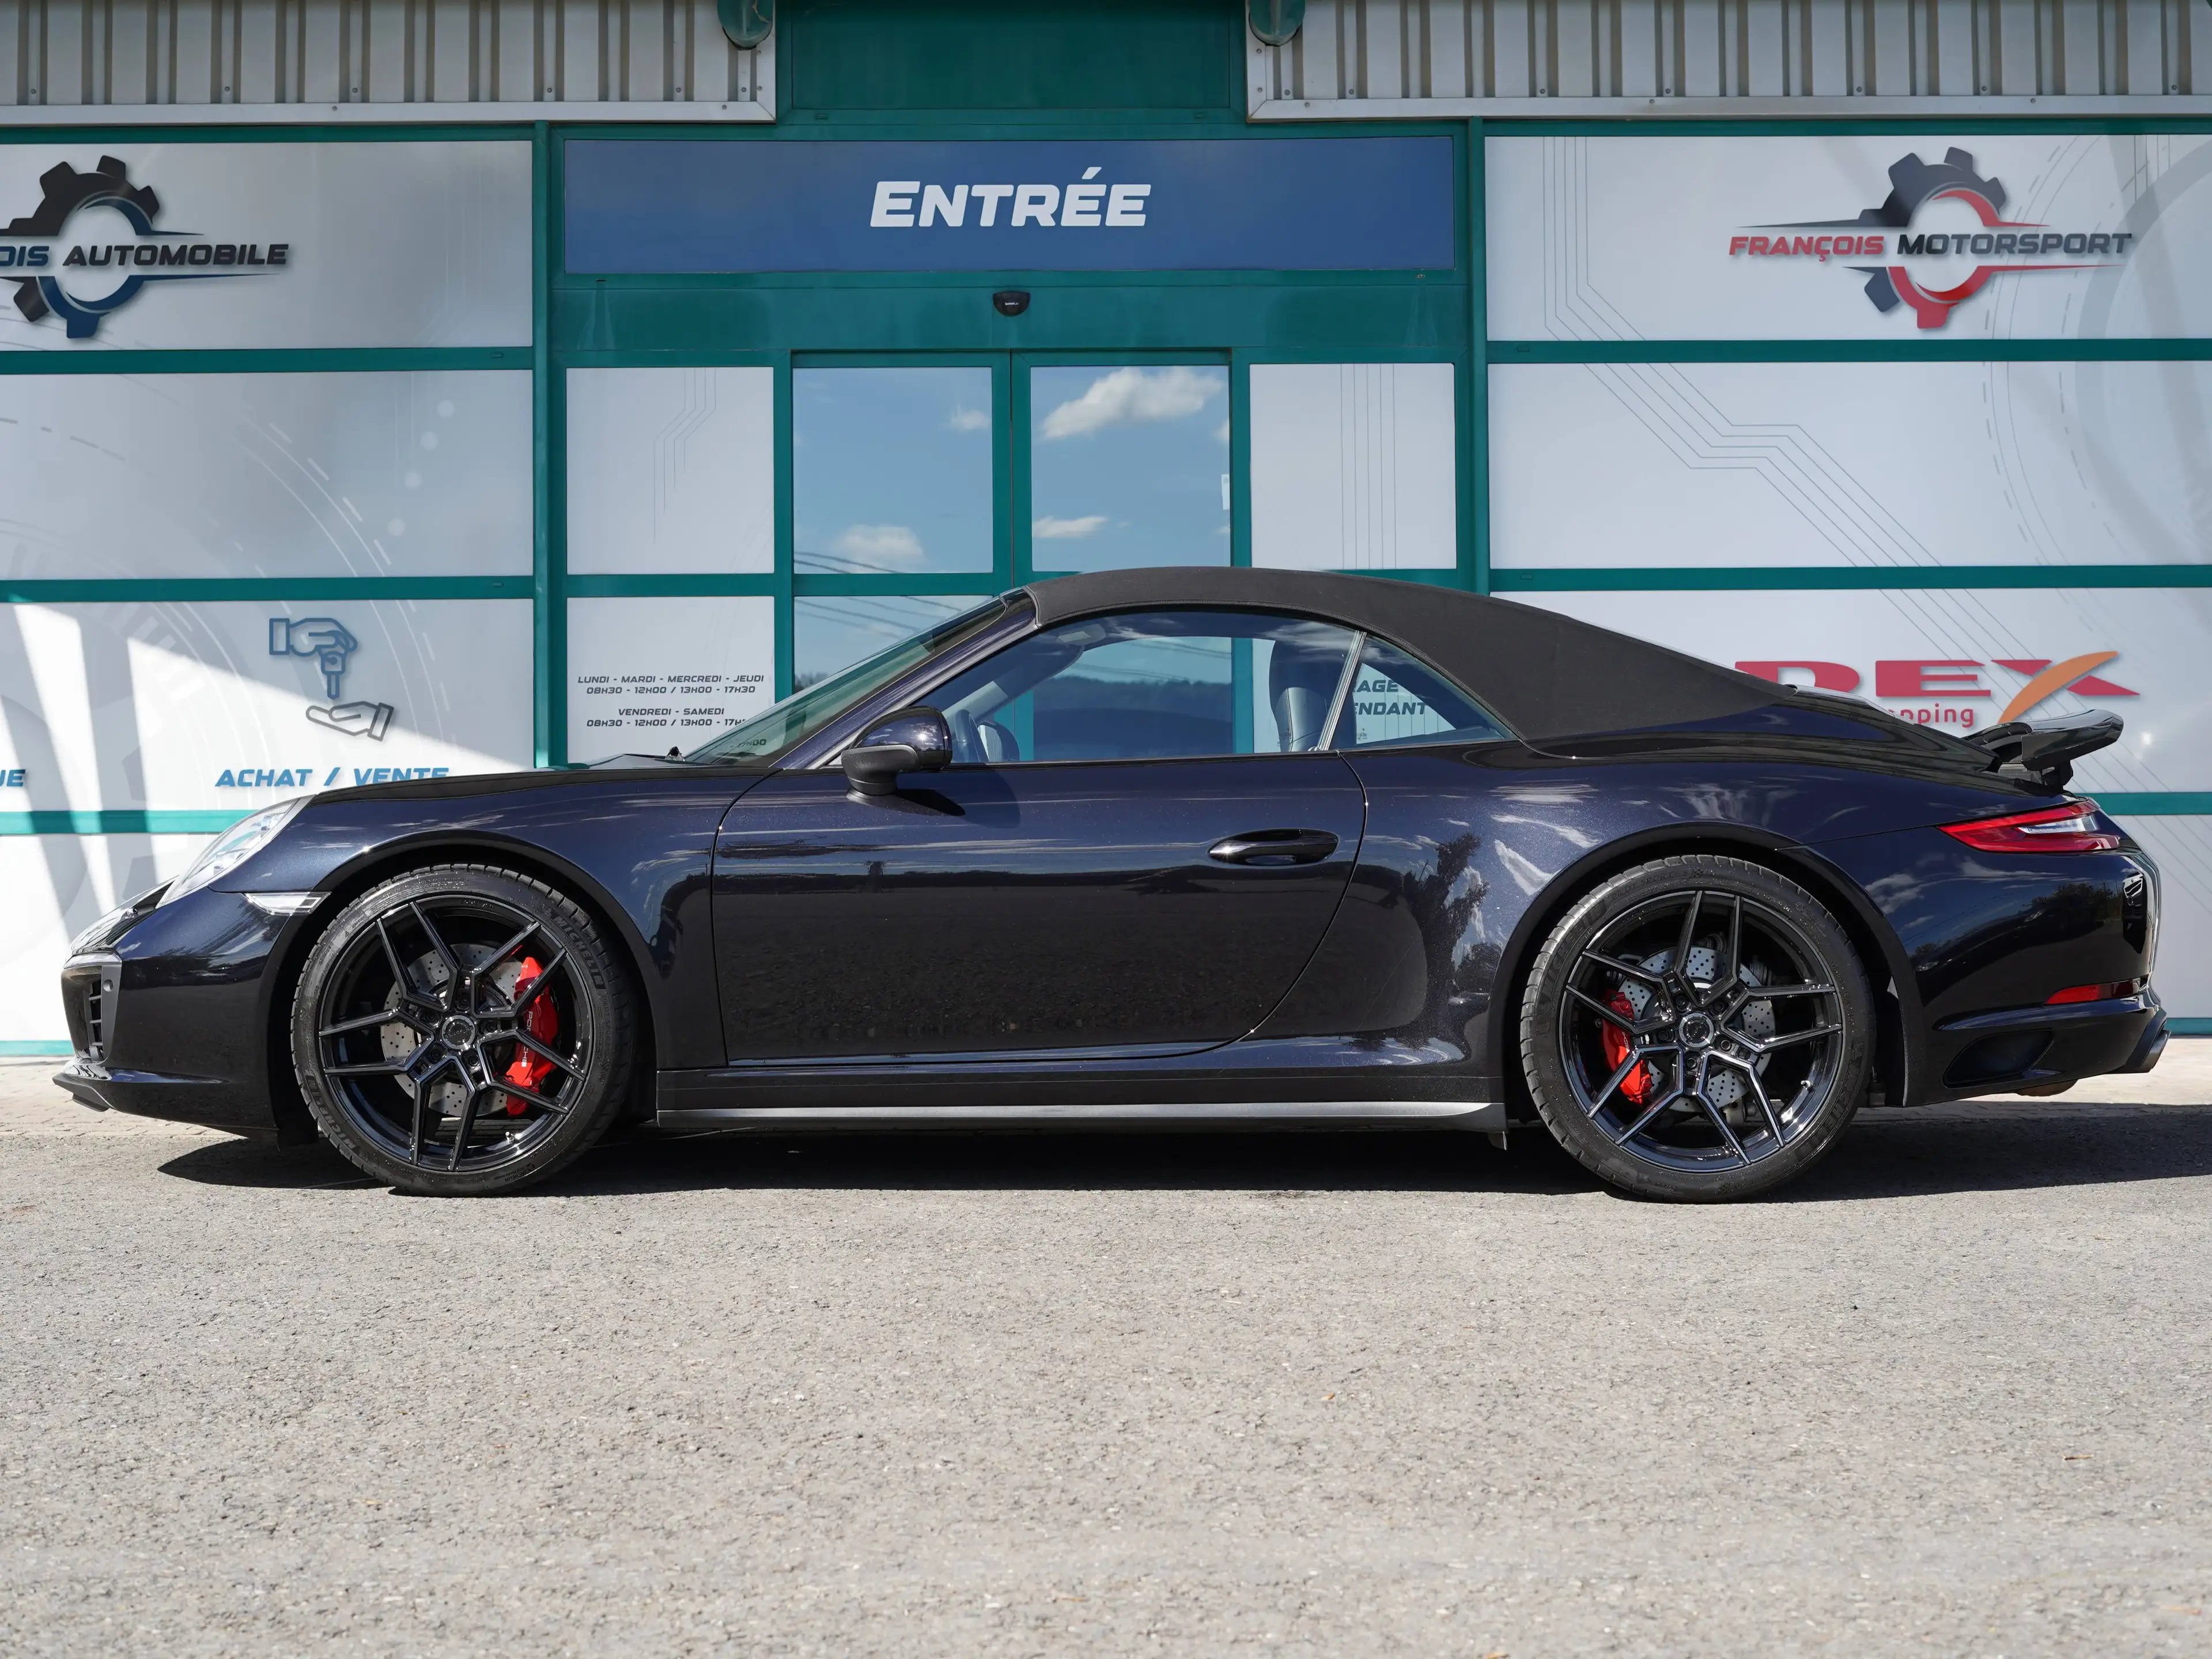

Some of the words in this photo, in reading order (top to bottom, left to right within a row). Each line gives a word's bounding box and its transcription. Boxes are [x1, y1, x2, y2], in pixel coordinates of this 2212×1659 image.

[62, 244, 289, 266] AUTOMOBILE
[1729, 236, 1884, 262] FRANÇOIS
[1896, 233, 2132, 255] MOTORSPORT
[1354, 680, 1398, 692] AGE
[215, 769, 313, 787] ACHAT
[323, 767, 341, 786] /
[553, 915, 605, 987] MICHELIN
[307, 1078, 357, 1150] MICHELIN
